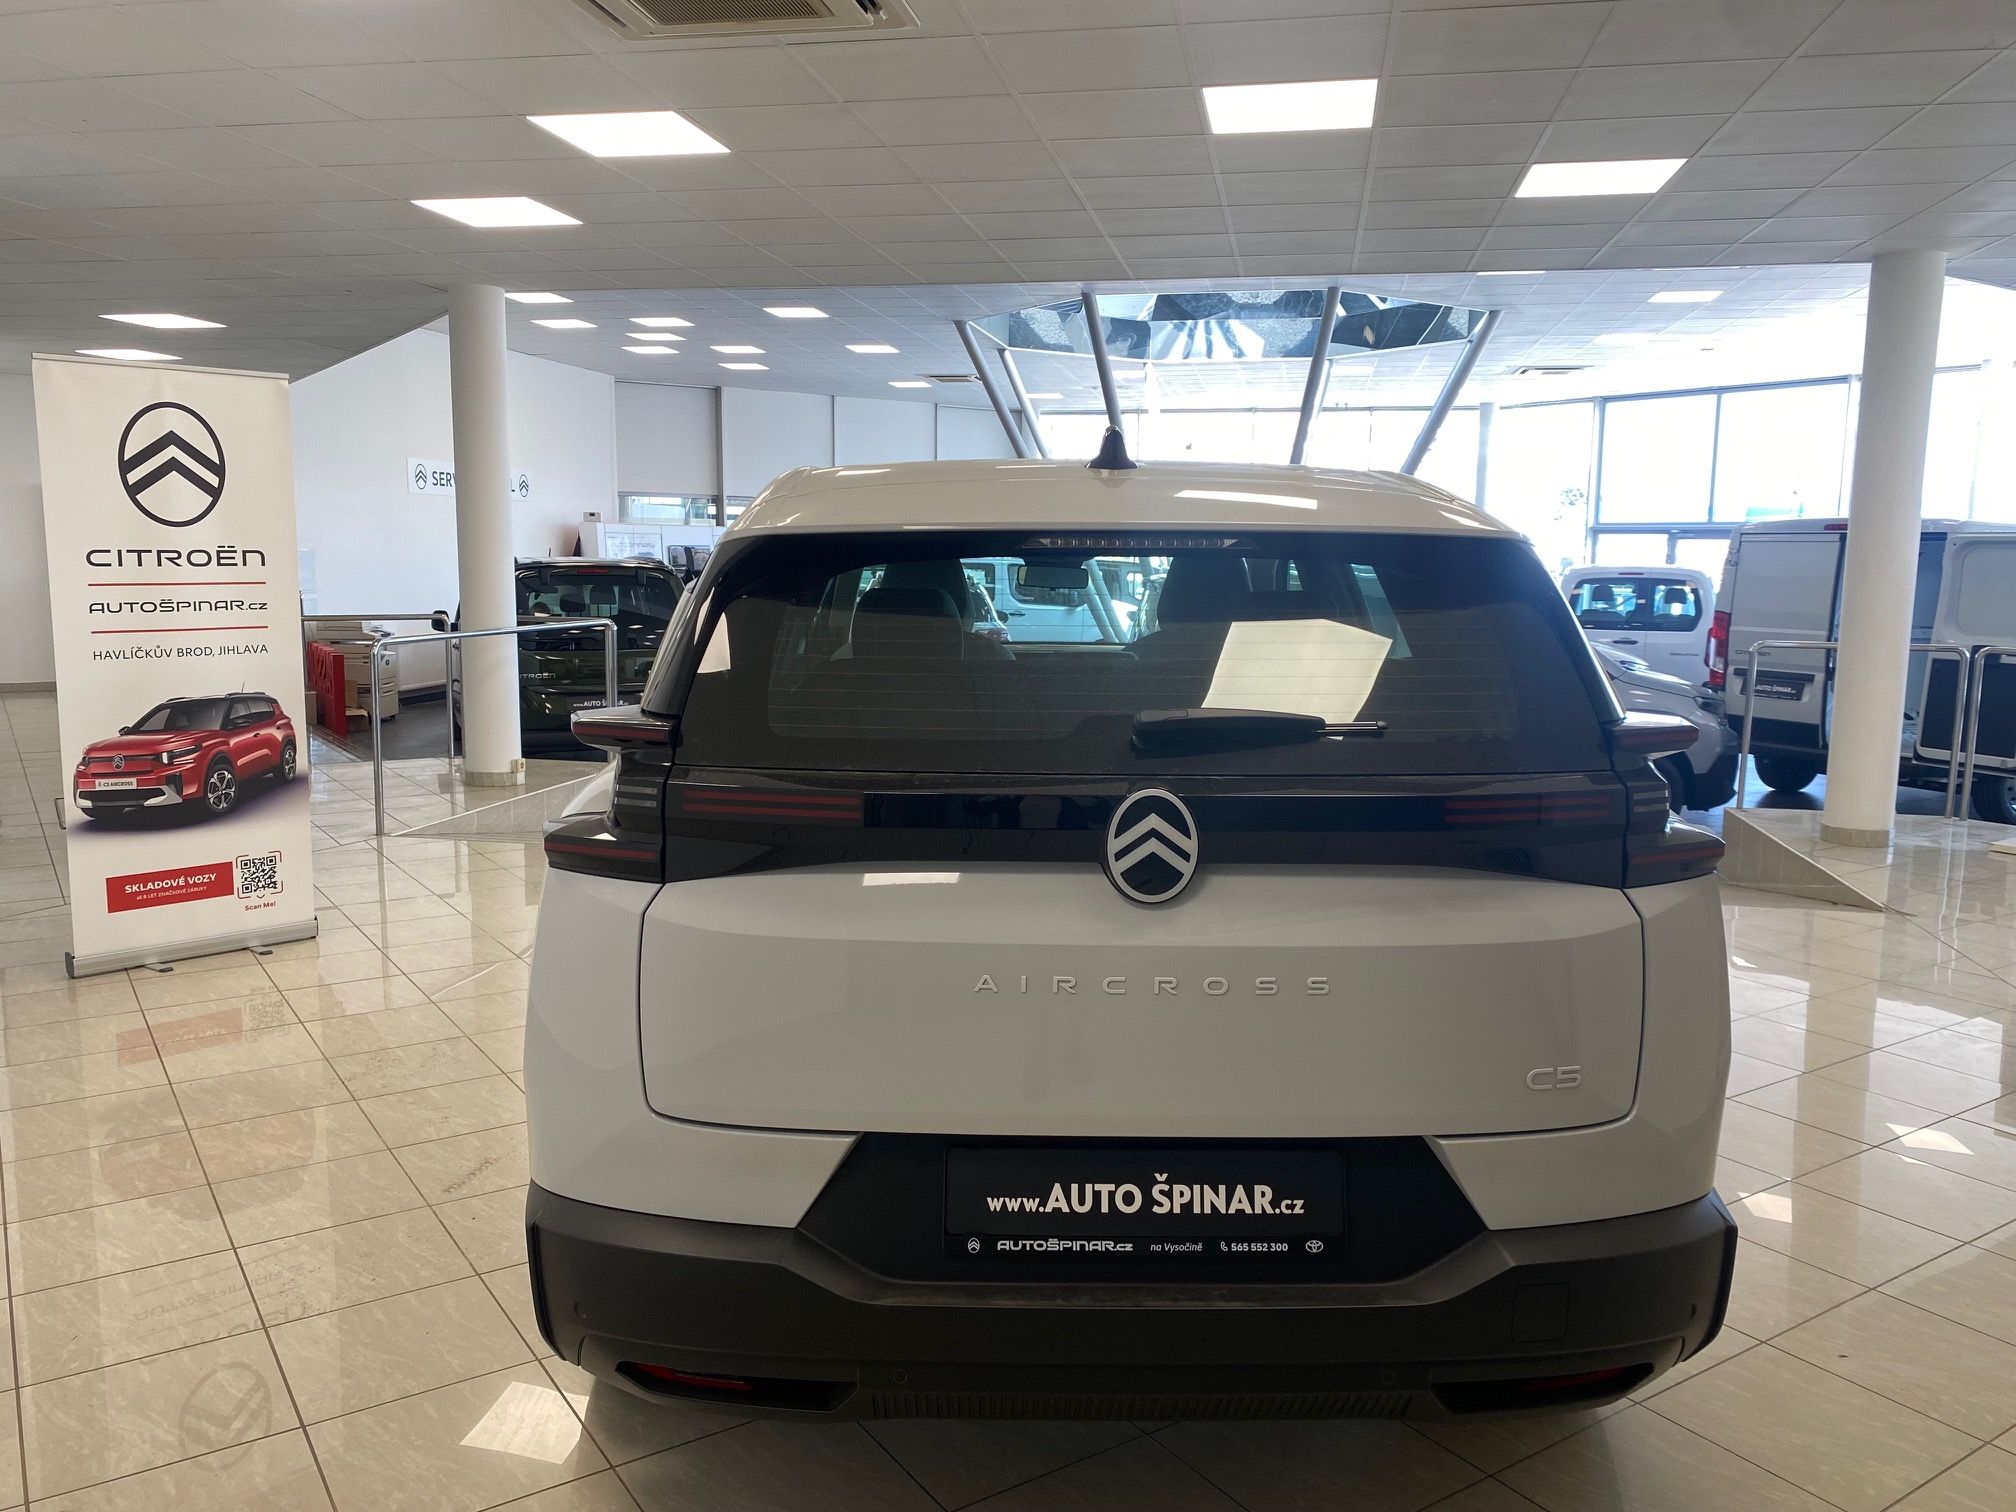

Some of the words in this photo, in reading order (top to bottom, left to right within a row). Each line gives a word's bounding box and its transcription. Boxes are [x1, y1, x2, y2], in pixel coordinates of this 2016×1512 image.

[86, 545, 266, 567] CITROËN
[89, 599, 268, 614] AUTOŠPINAR.cz
[93, 643, 172, 661] HAVLÍČKŮV
[177, 647, 215, 659] BROD,
[218, 644, 269, 657] JIHLAVA
[124, 875, 186, 894] SKLADOVÉ
[187, 872, 217, 885] VOZY
[244, 903, 262, 911] Scan
[973, 974, 1331, 996] AIRCROSS
[1525, 1065, 1582, 1090] C5
[986, 1183, 1143, 1214] www.AUTO
[1151, 1173, 1305, 1215] ŠPINAR.cz
[997, 1238, 1133, 1252] AUTOŠPINAR.cz
[1150, 1244, 1162, 1252] na
[1164, 1241, 1203, 1254] Vysočině
[1231, 1243, 1249, 1252] 565
[1250, 1243, 1268, 1252] 552
[1270, 1243, 1289, 1252] 300
